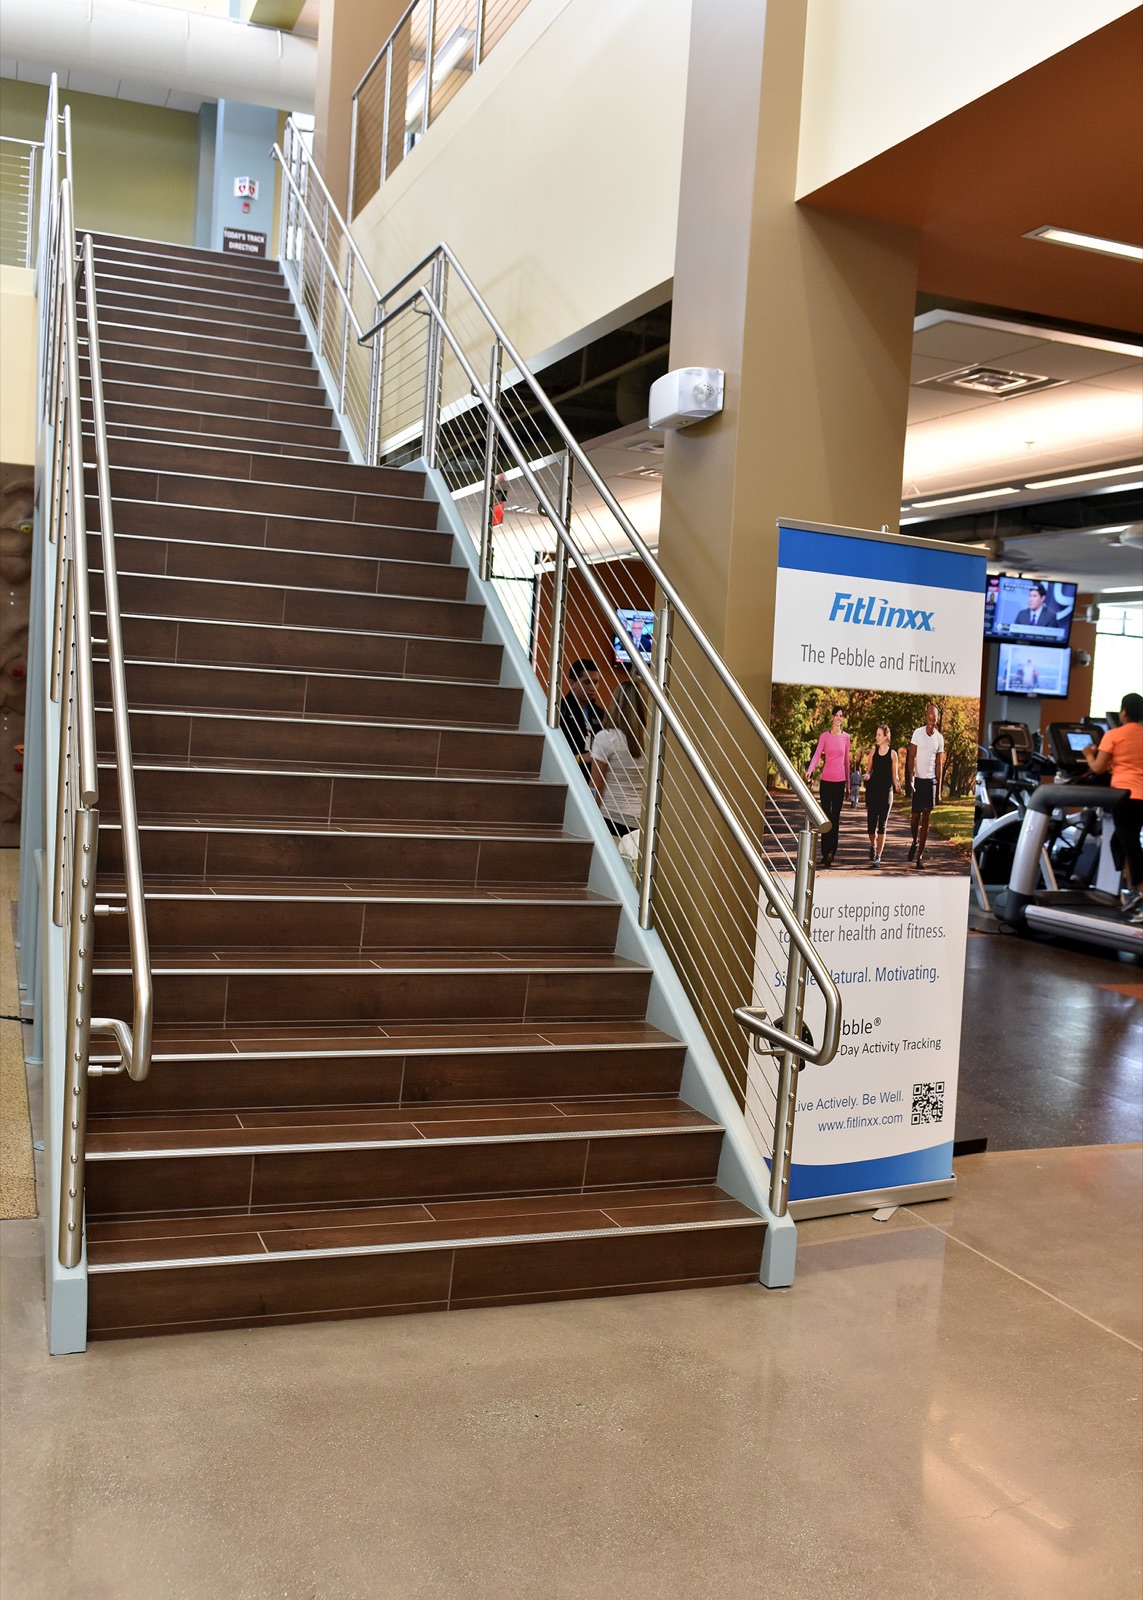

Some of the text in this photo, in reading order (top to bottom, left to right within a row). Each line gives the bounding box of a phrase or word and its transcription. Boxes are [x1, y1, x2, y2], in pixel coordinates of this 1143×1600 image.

[223, 230, 265, 243] TODAY'S TRACK
[229, 241, 259, 253] DIRECTION
[801, 644, 957, 676] The Pebble and FitLinxx
[812, 901, 926, 922] our stepping stone
[809, 927, 835, 943] tter
[838, 924, 876, 942] health
[880, 923, 903, 940] and
[907, 921, 946, 939] fitness.
[831, 966, 871, 986] atural.
[875, 964, 940, 984] Motivating.
[861, 1039, 900, 1056] Activity
[902, 1037, 942, 1052] Tracking
[795, 1090, 904, 1113] ive Actively. Be Well.
[818, 1113, 904, 1132] www.fitlinxx.com
